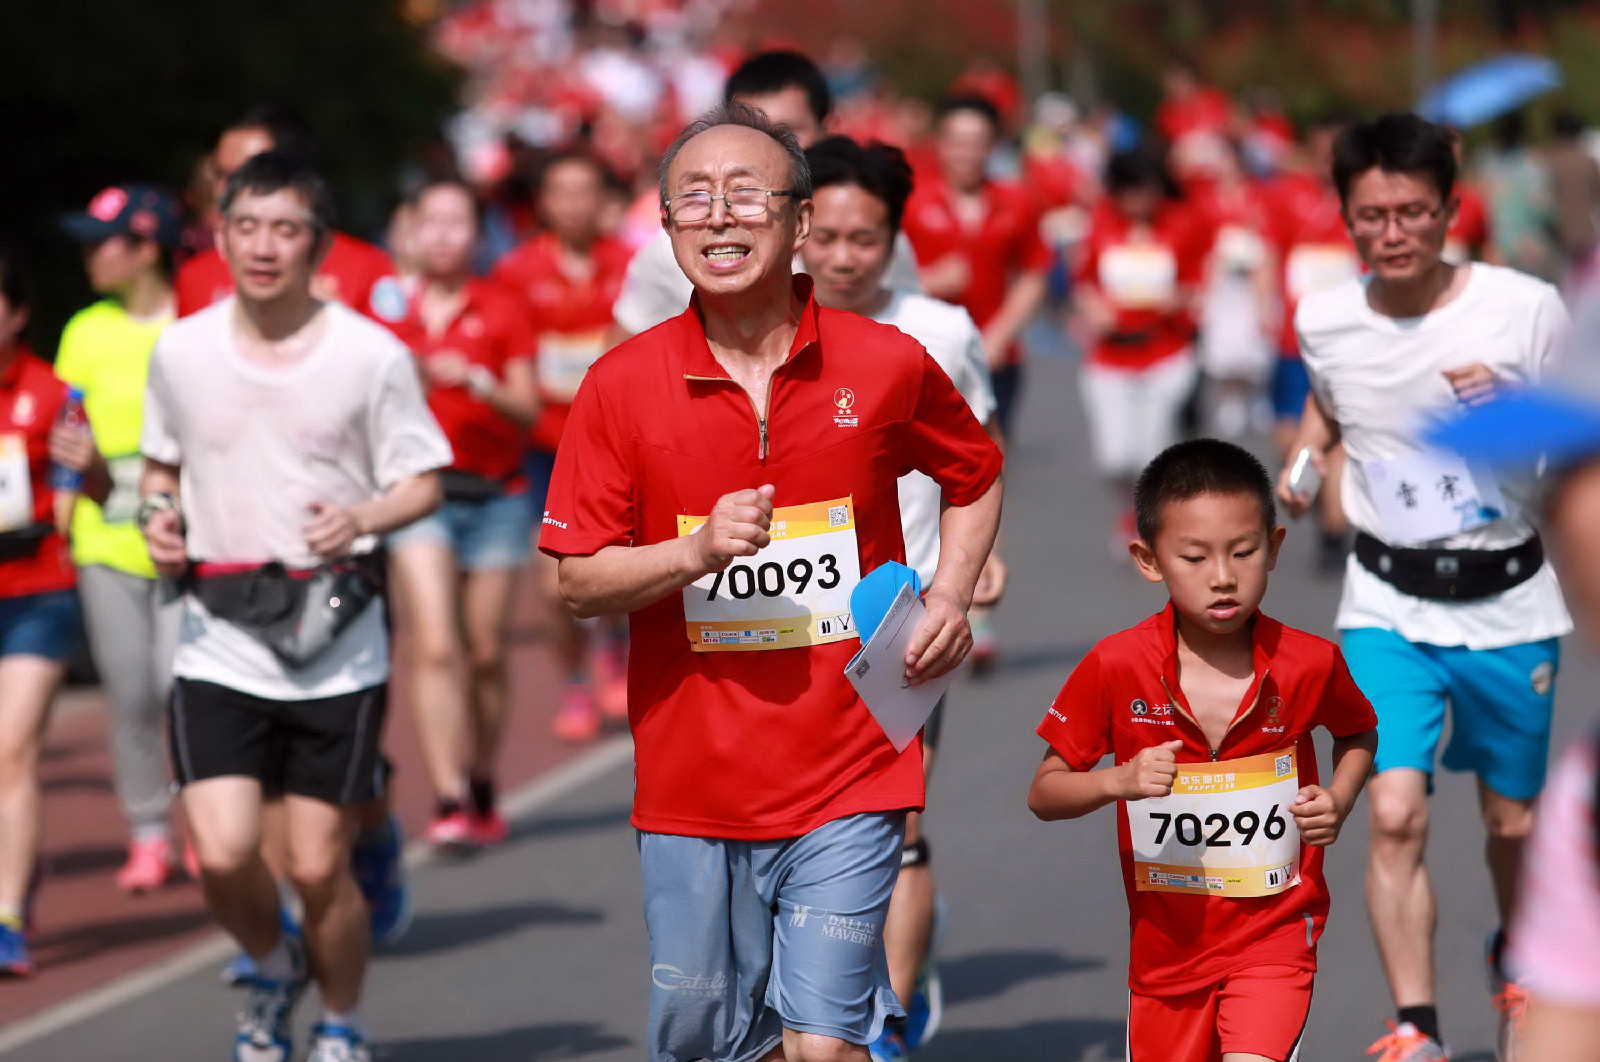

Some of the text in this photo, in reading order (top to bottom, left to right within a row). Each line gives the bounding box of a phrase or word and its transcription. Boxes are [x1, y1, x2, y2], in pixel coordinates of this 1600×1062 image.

[706, 553, 841, 601] 70093
[1149, 803, 1286, 847] 70296
[828, 914, 876, 934] DALLAS
